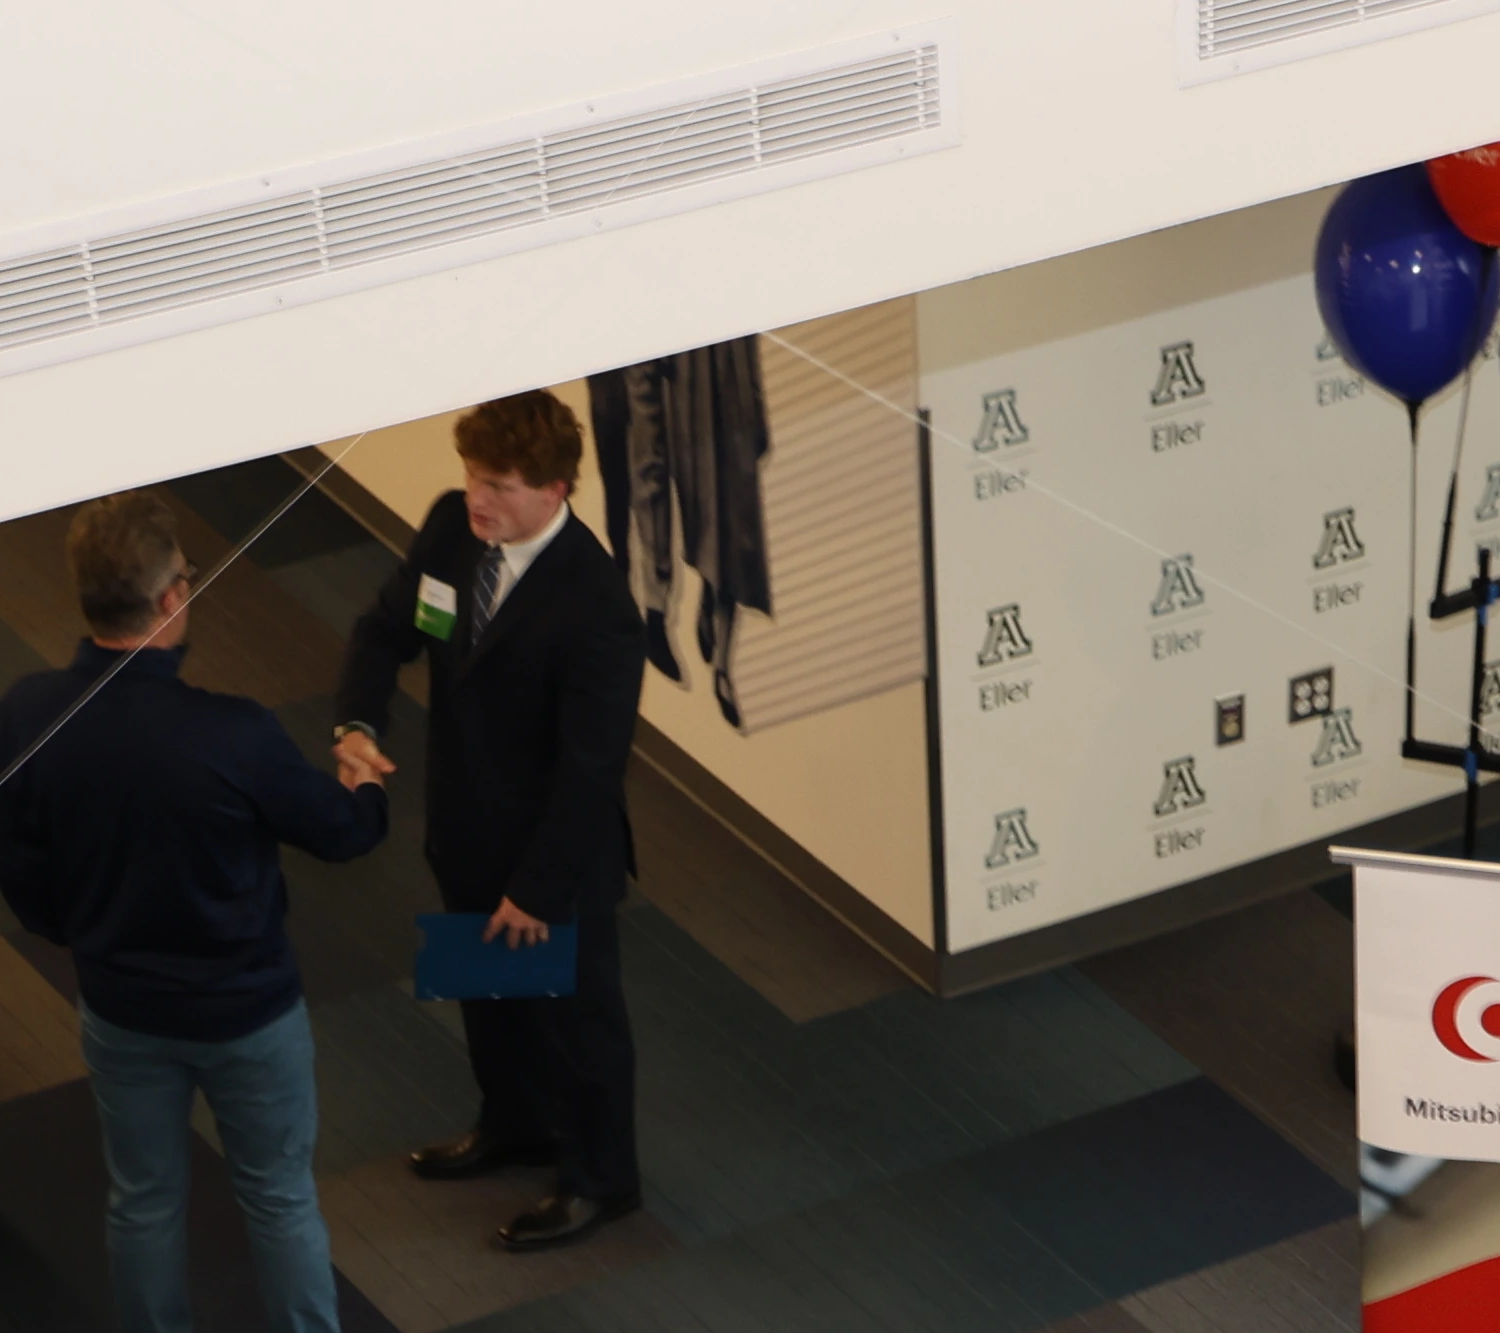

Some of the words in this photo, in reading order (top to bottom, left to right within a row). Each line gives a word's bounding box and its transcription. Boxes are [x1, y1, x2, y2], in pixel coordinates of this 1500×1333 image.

[1151, 420, 1205, 452] Eller
[974, 471, 1028, 501] Eller
[1313, 582, 1364, 612] Eller
[1151, 629, 1203, 661] Eller
[977, 678, 1032, 712] Eller
[1310, 777, 1361, 809] Eller
[1154, 827, 1206, 859] Eller
[986, 878, 1038, 911] Eller
